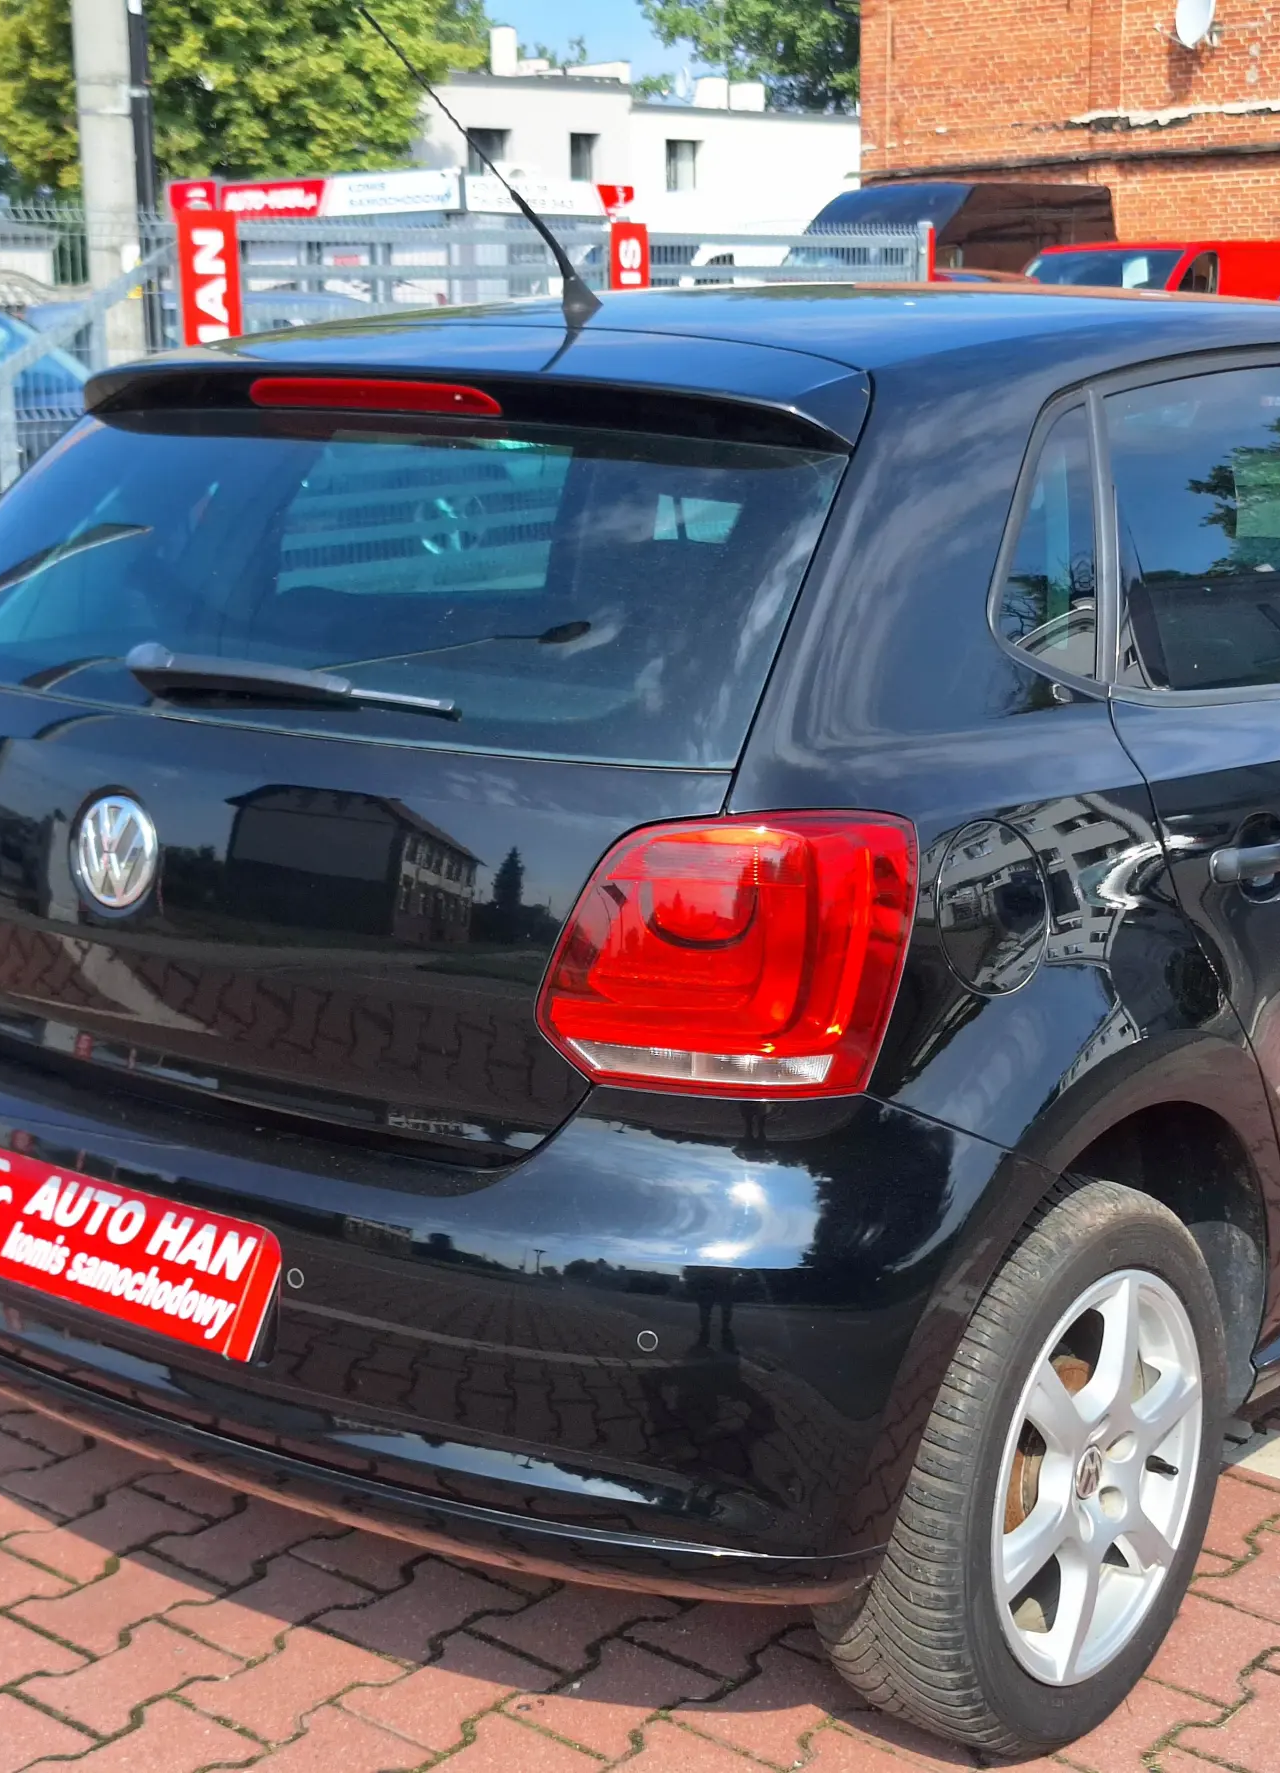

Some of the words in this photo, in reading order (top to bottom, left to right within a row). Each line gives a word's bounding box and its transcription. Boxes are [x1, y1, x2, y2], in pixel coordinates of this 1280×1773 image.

[0, 1221, 71, 1276] komis
[66, 1252, 237, 1340] samochodowy
[23, 1176, 147, 1245] AUTO
[146, 1214, 258, 1282] HAN
